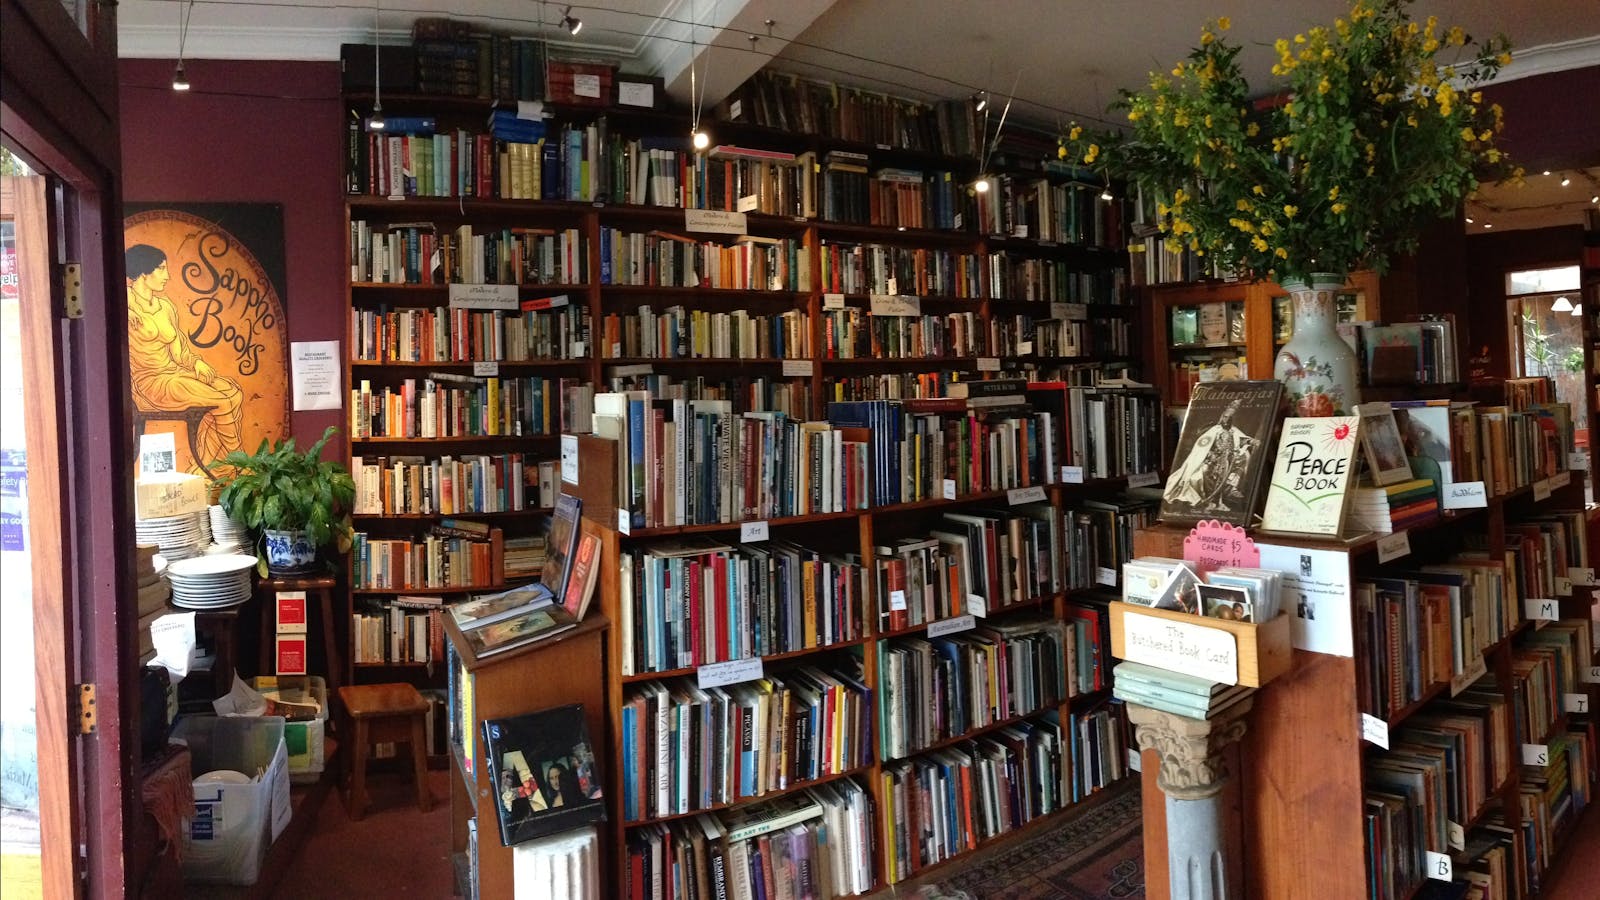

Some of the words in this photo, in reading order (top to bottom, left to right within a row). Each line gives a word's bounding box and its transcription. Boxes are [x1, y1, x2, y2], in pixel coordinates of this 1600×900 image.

[181, 231, 275, 335] Sappho
[188, 294, 266, 376] Books
[1192, 385, 1275, 404] Maharajas
[723, 411, 731, 448] PRIVATE
[722, 449, 730, 471] VIEW
[1286, 441, 1348, 476] PEACE
[1293, 477, 1339, 491] BOOK
[748, 527, 761, 538] Art
[1201, 543, 1224, 552] CARDS
[1231, 539, 1242, 554] $5
[1563, 581, 1572, 591] P
[1541, 603, 1553, 617] M
[1165, 625, 1184, 638] The
[1179, 640, 1201, 660] Book
[1206, 647, 1230, 664] Card
[1577, 700, 1585, 712] T
[660, 706, 668, 768] BYZANTINE
[1537, 753, 1547, 764] S
[660, 770, 668, 792] ART
[1450, 830, 1458, 844] C
[1436, 857, 1449, 876] B
